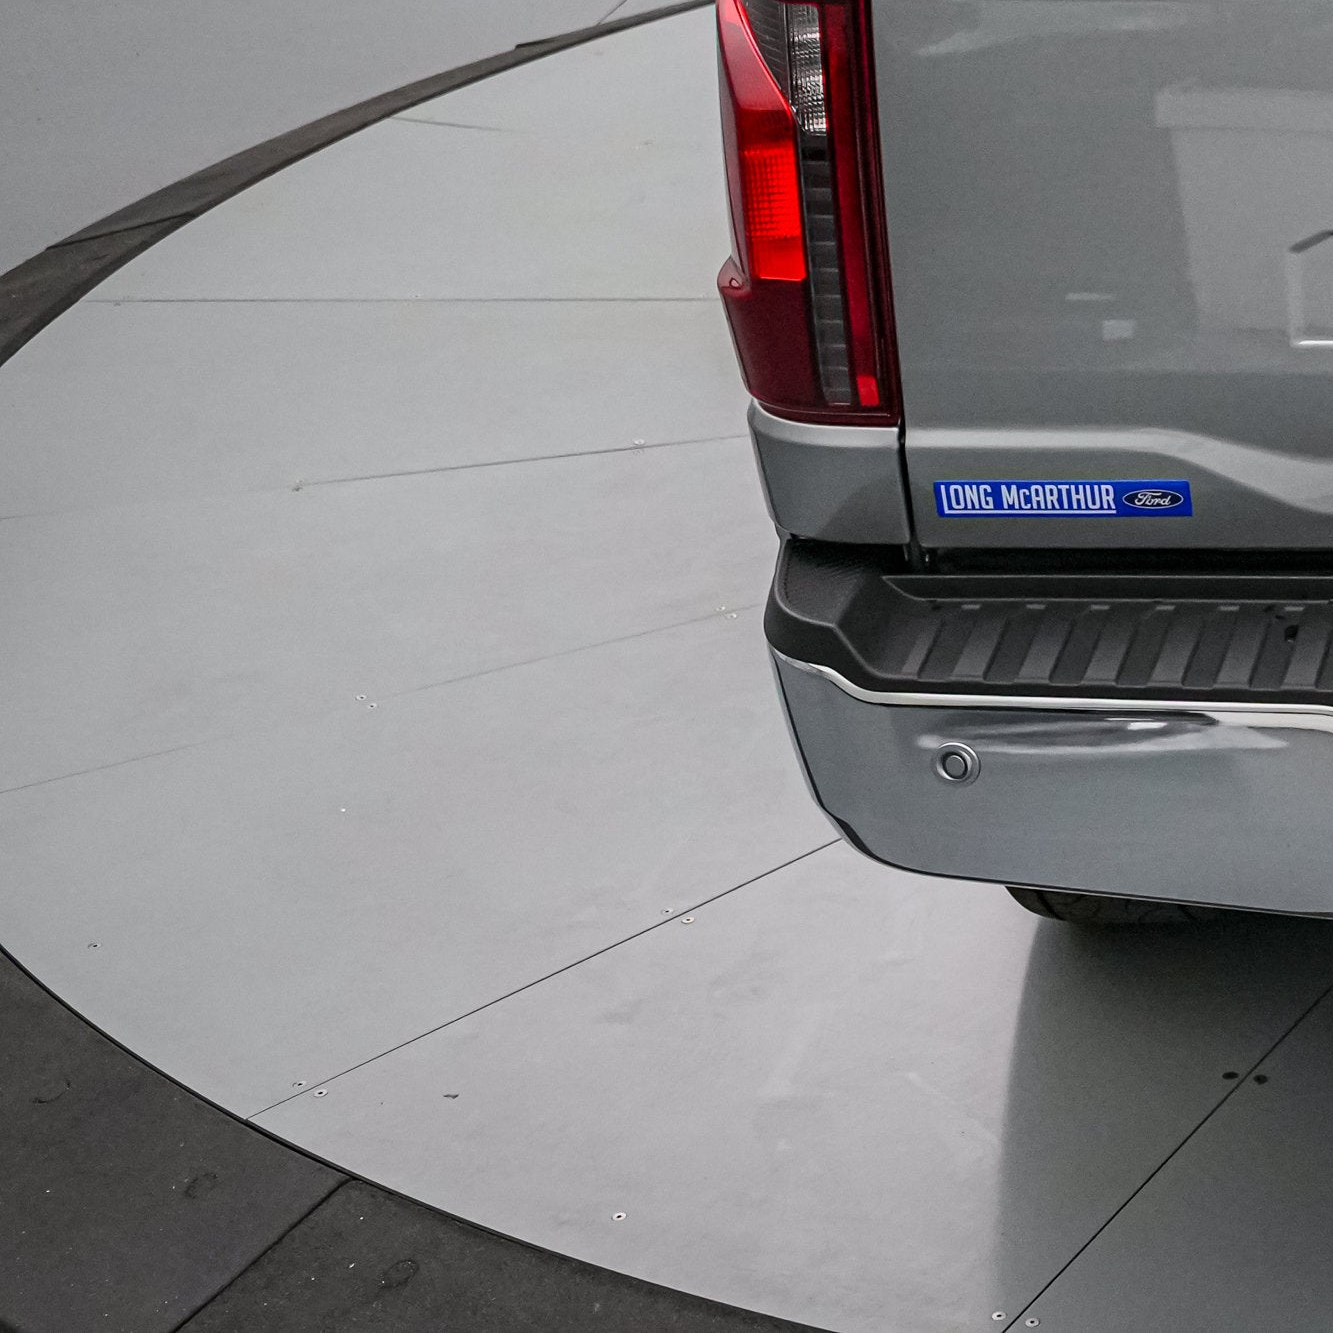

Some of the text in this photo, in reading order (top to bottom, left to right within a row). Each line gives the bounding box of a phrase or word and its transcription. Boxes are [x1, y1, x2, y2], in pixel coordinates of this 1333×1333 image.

[940, 484, 1172, 513] LONG McARTHUR Ford
